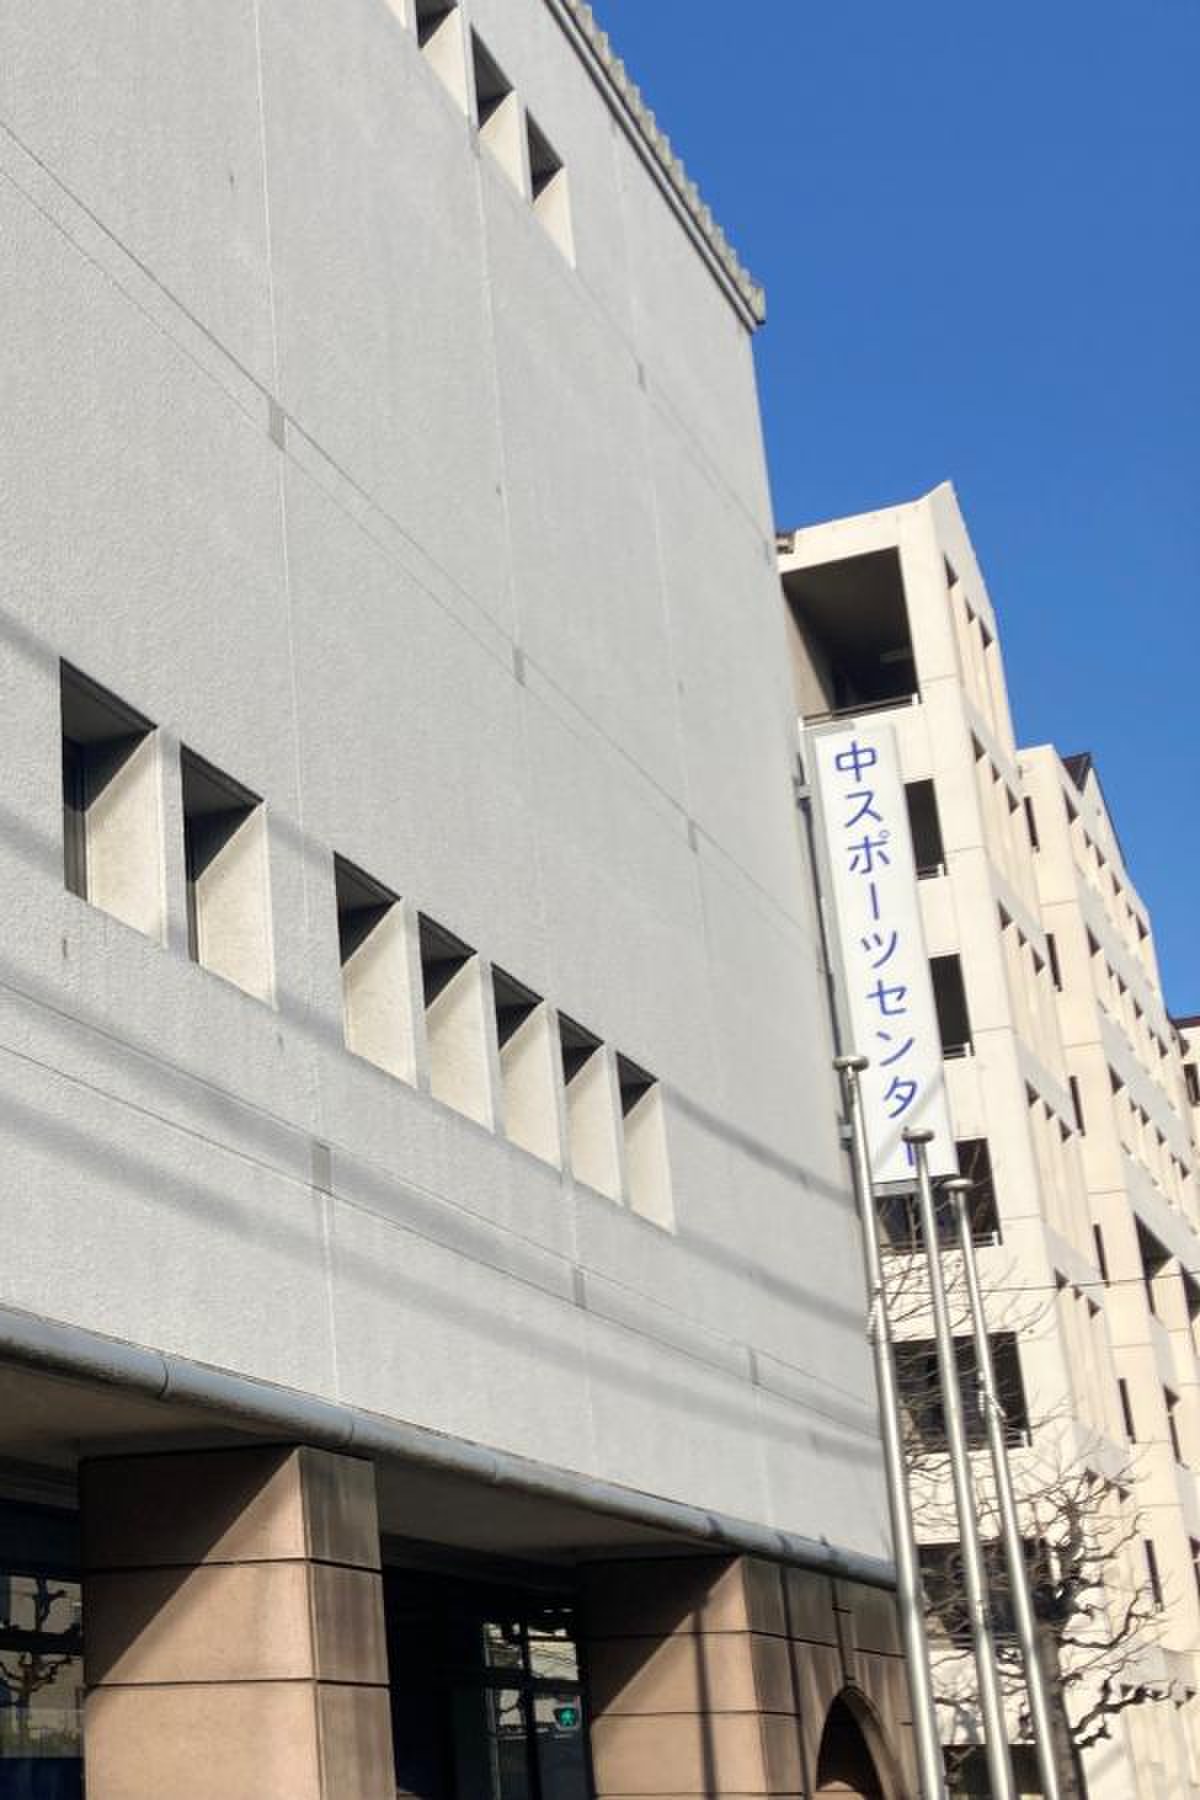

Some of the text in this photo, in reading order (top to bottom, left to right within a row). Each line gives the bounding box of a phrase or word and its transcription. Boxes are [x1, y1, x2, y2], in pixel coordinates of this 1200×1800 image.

[835, 740, 918, 1166] 中スポーツセンター
